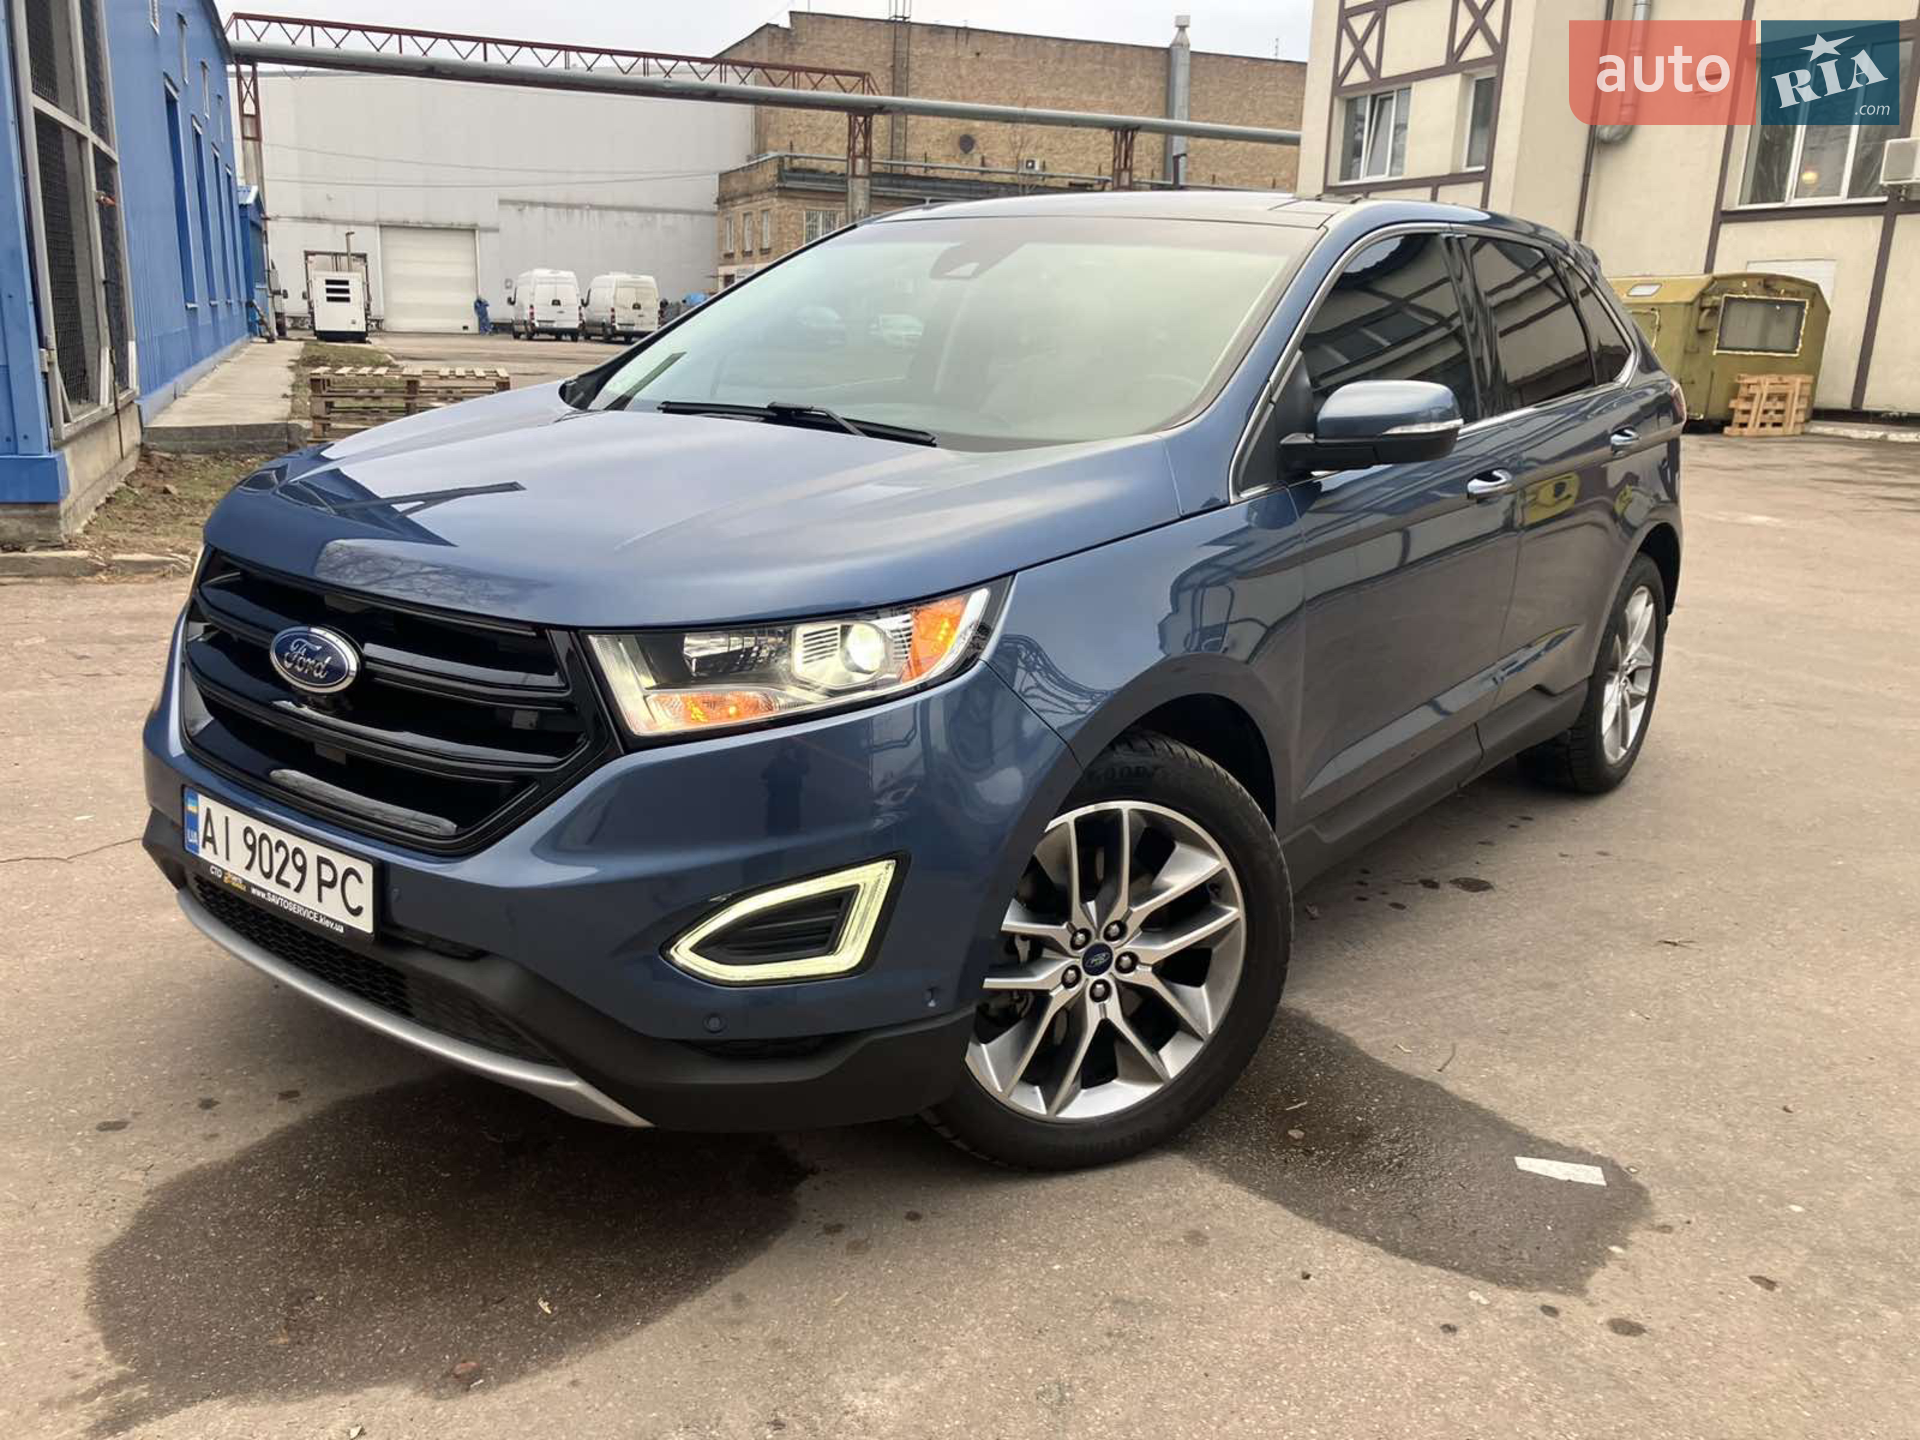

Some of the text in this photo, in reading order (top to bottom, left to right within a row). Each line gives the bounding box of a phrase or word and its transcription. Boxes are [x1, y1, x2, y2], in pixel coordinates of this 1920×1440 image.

[284, 638, 332, 678] Ford
[243, 826, 307, 893] 9029
[317, 855, 364, 917] PC
